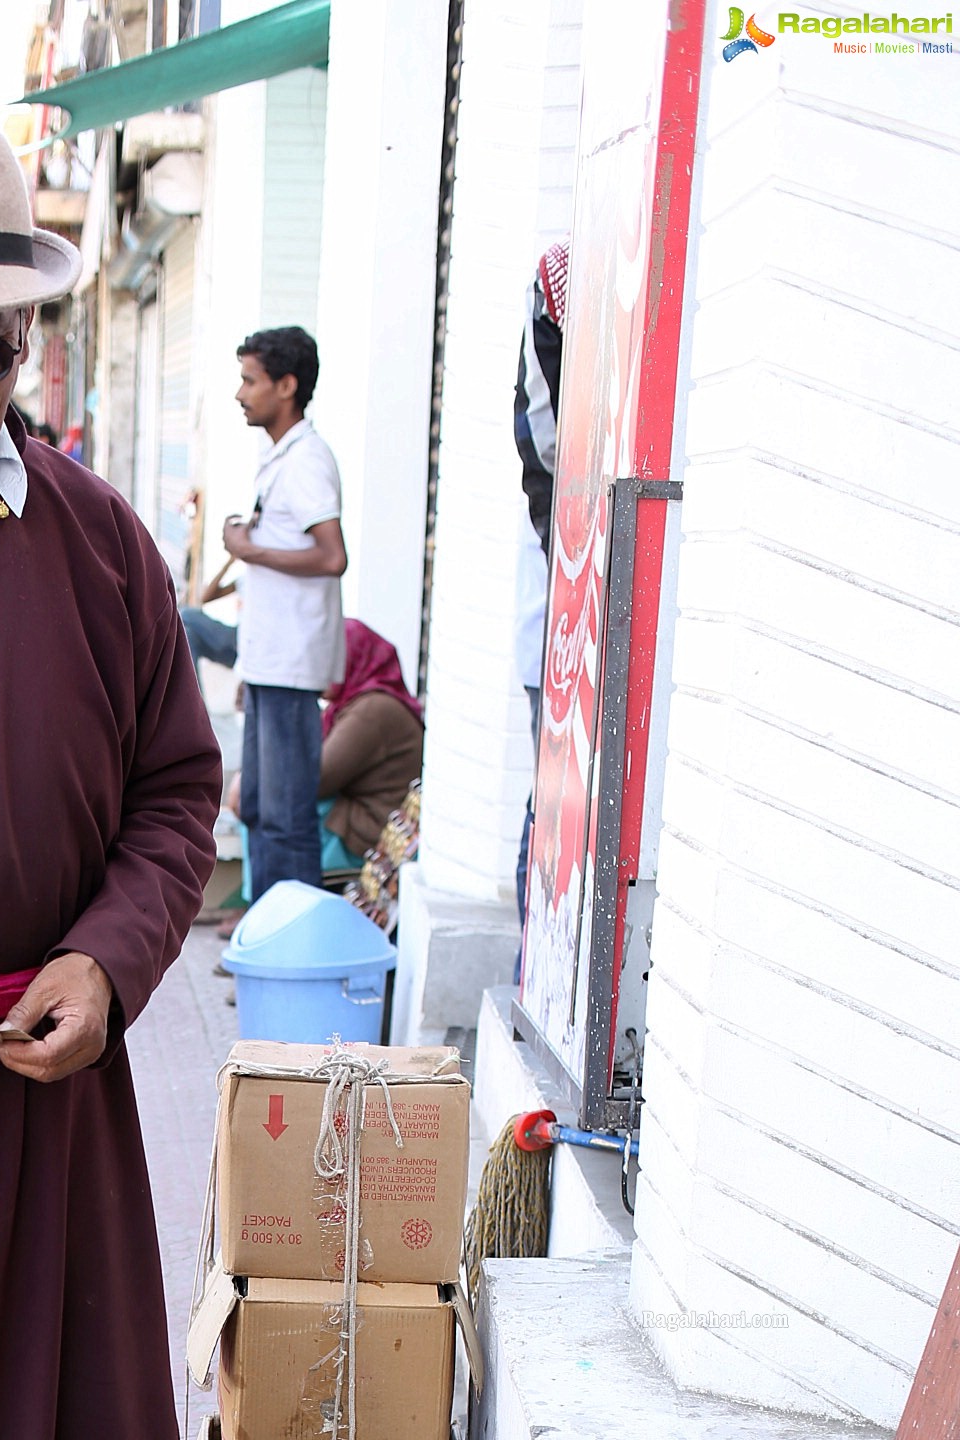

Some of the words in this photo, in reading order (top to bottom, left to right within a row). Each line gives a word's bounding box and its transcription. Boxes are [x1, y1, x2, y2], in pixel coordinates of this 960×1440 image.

[394, 1112, 439, 1120] MARKETING
[363, 1120, 402, 1128] C-OPER
[378, 1175, 436, 1184] CO-OPERETIVE
[378, 1184, 435, 1192] BANASKANTHA
[371, 1193, 435, 1201] MANUFACTURED
[242, 1215, 291, 1227] PACKET
[241, 1229, 248, 1241] g
[252, 1232, 272, 1244] 500
[276, 1233, 284, 1244] X
[288, 1234, 302, 1244] 30
